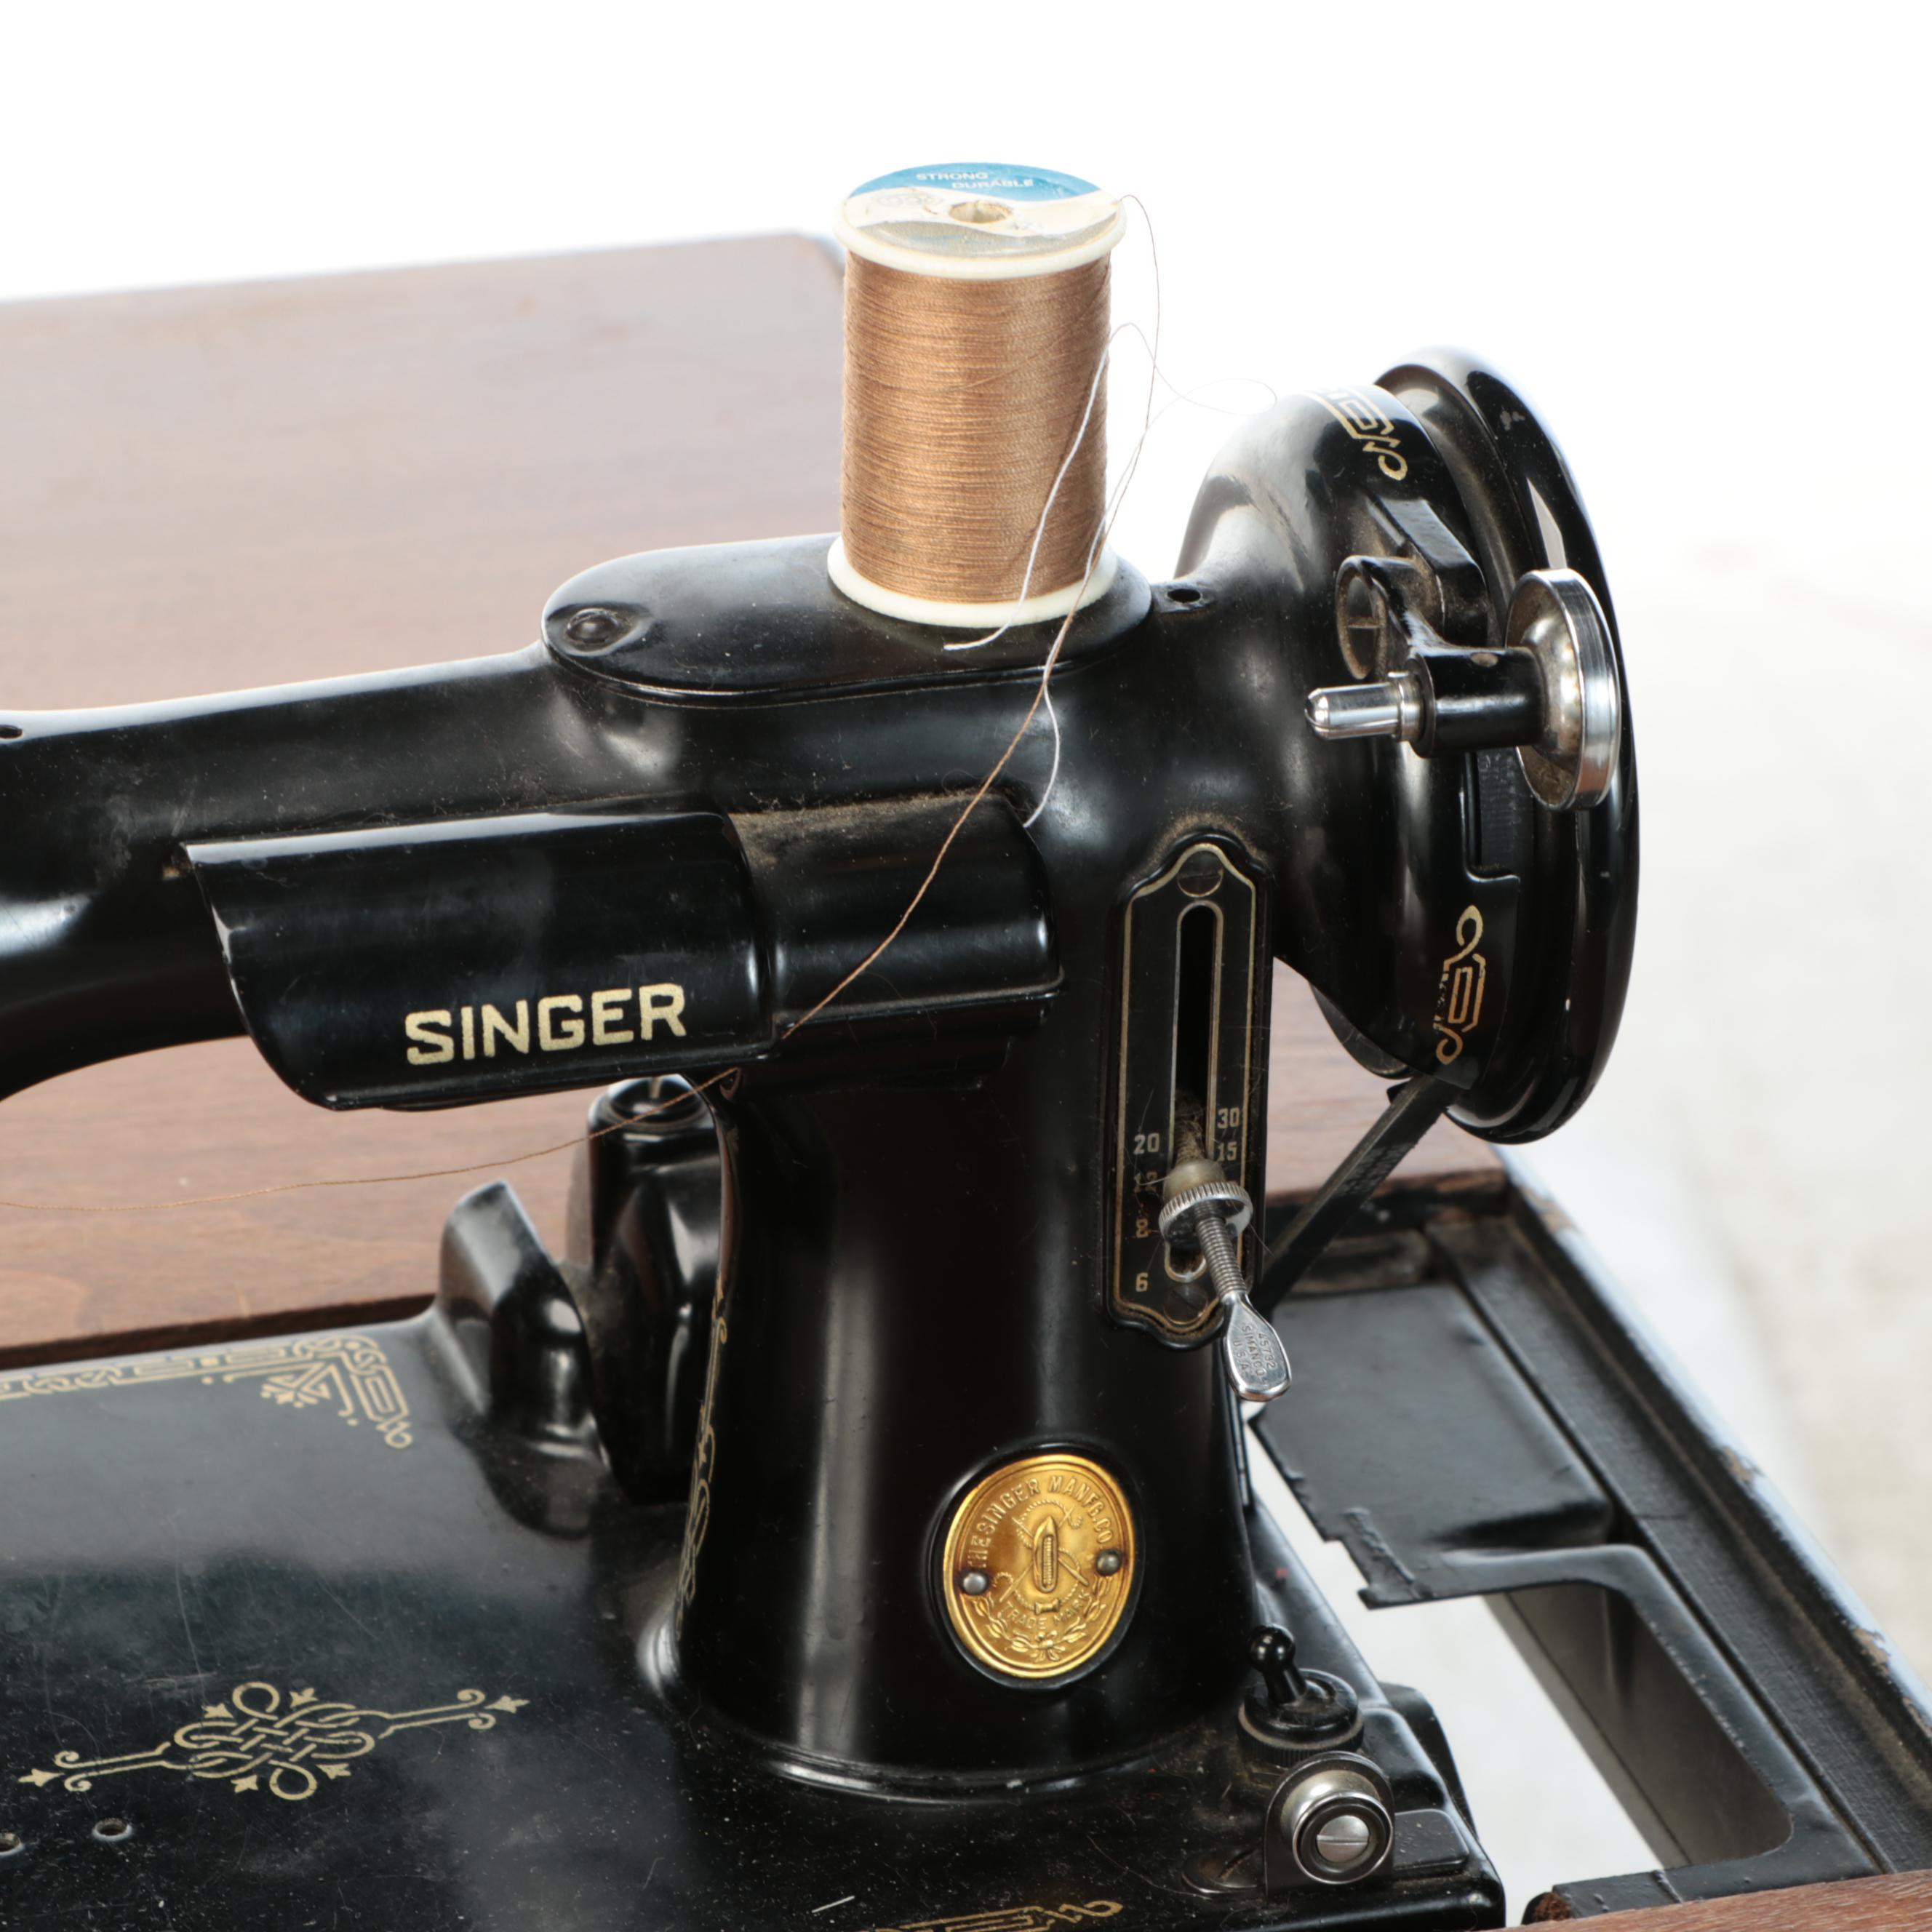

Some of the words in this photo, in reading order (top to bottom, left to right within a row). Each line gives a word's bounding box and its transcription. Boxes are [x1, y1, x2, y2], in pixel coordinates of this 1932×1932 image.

[915, 172, 989, 181] STRONG
[951, 179, 1034, 189] DURABLE
[404, 983, 687, 1065] SINGER
[1217, 1108, 1240, 1128] 30
[1133, 1133, 1159, 1154] 20
[1217, 1142, 1237, 1162] 15
[1133, 1170, 1158, 1193] 12
[1135, 1272, 1148, 1293] 6
[1241, 1324, 1266, 1376] SIMANCO
[976, 1478, 1041, 1534] SINGER
[1001, 1600, 1047, 1629] TRADE
